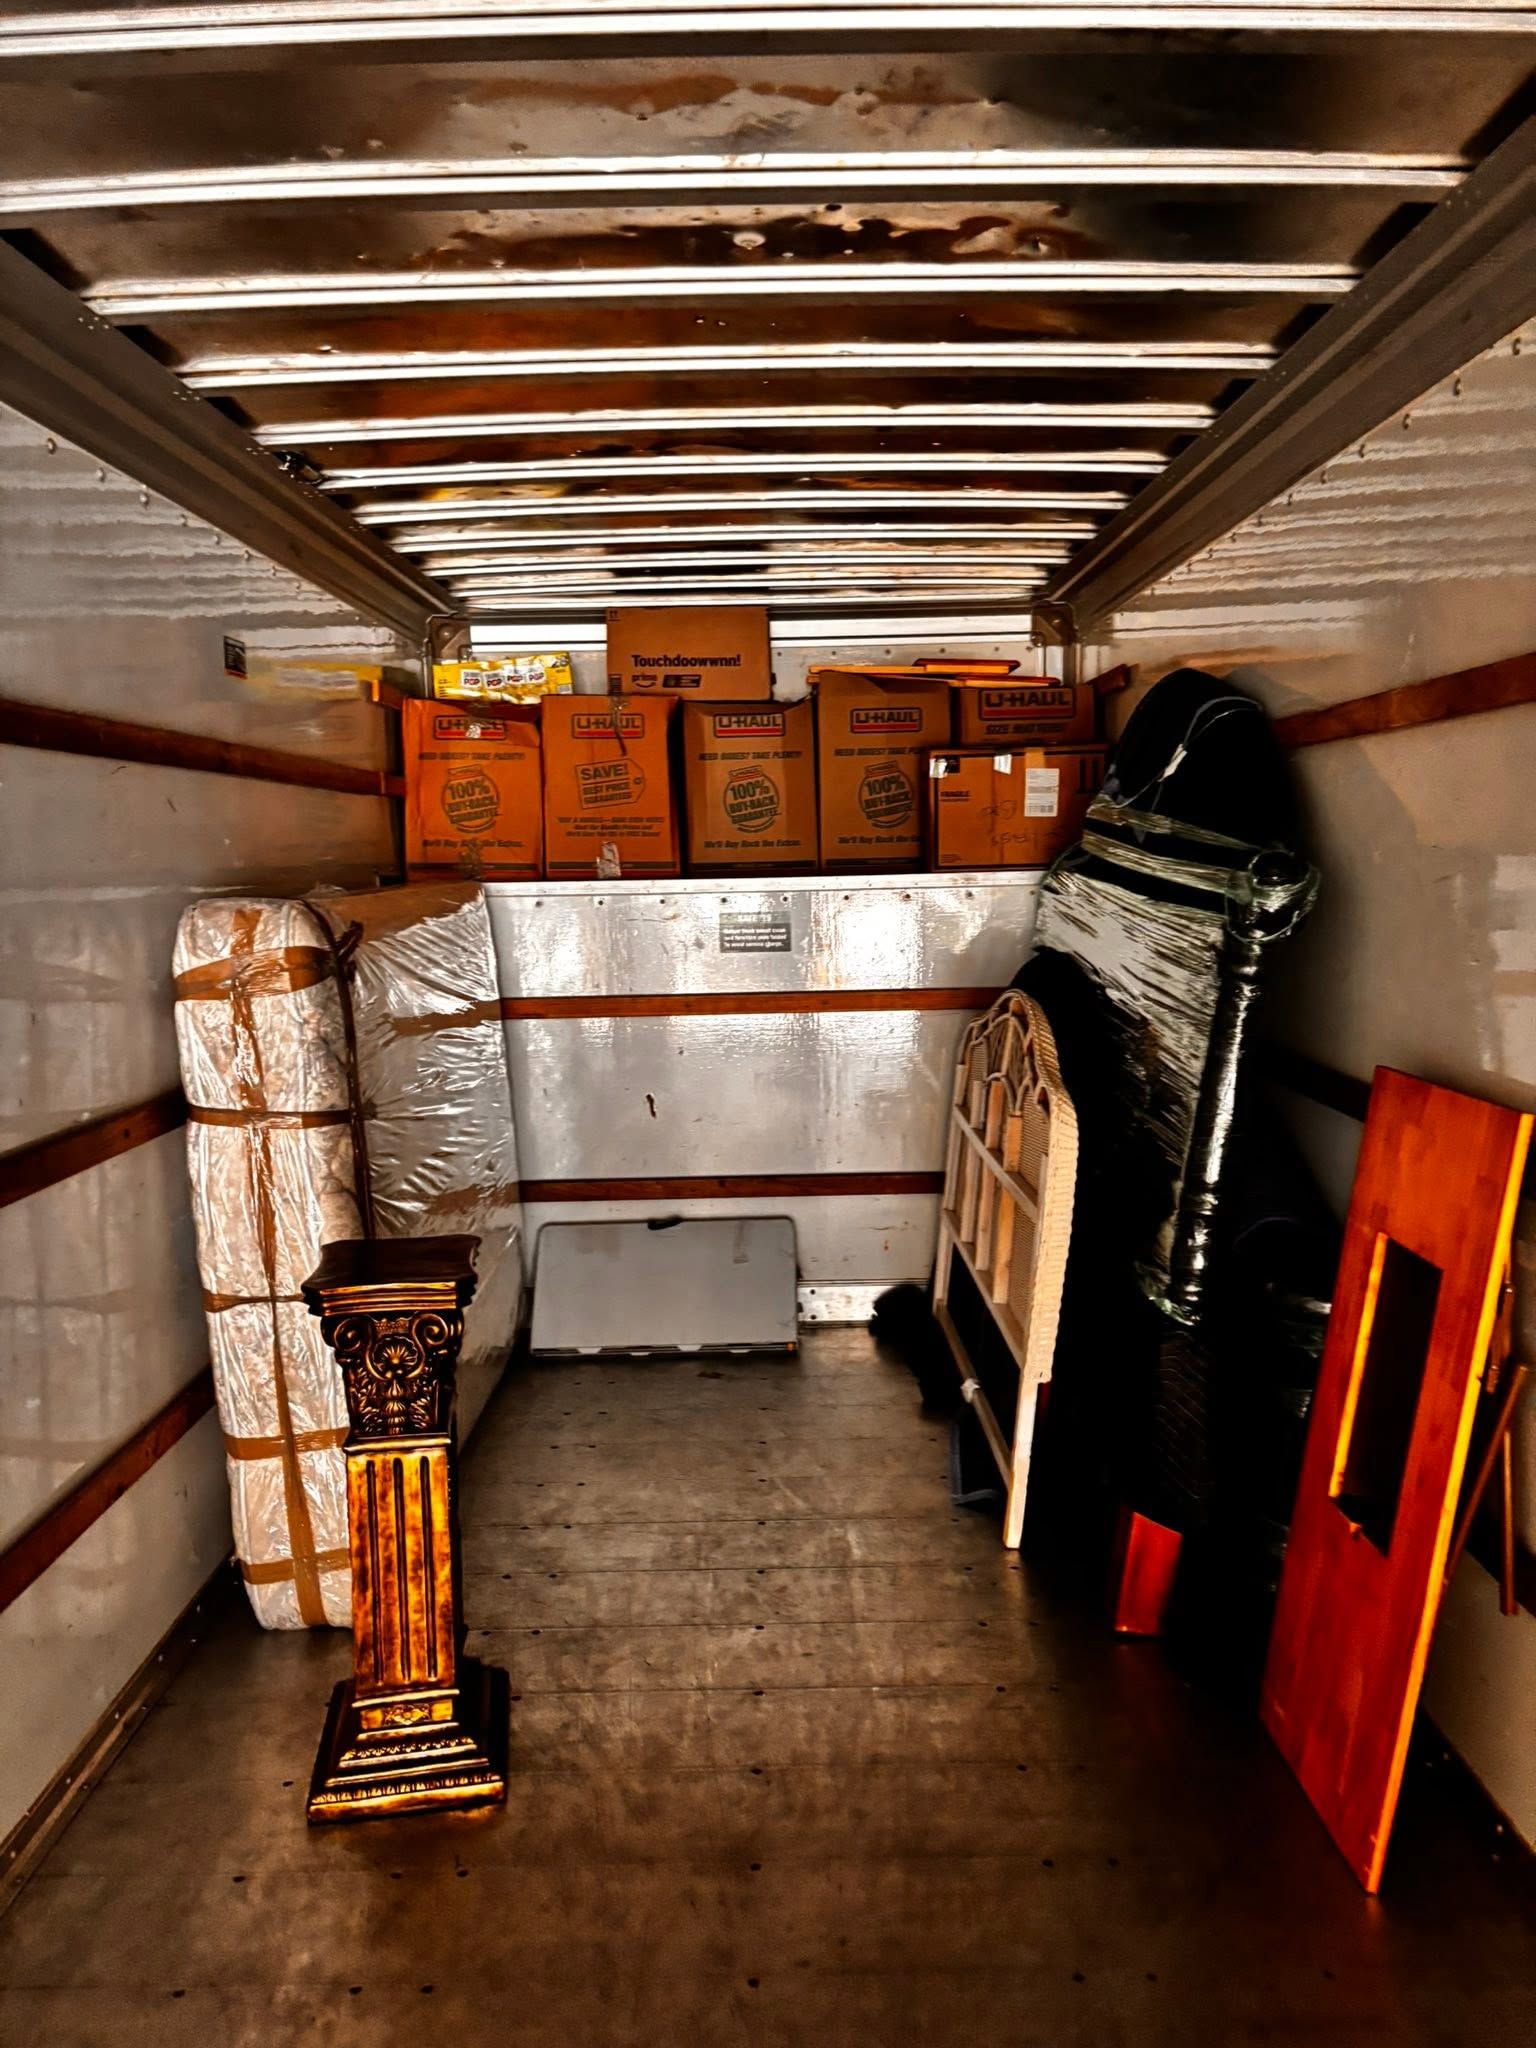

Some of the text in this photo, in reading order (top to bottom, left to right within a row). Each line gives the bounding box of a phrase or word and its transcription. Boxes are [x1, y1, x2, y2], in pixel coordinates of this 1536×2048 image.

[631, 653, 741, 668] Touchdoowwnn!
[463, 678, 480, 686] POP
[487, 679, 503, 688] POP
[507, 675, 523, 683] POP
[528, 672, 545, 681] POP
[984, 691, 1070, 708] U-HAUL
[576, 716, 641, 730] U-HAUL
[718, 715, 782, 728] U-HAUL
[855, 711, 919, 724] U-HAUL
[581, 763, 628, 780] SAVE!
[448, 779, 491, 800] 100%
[729, 779, 770, 801] 100%
[864, 775, 906, 796] 100%
